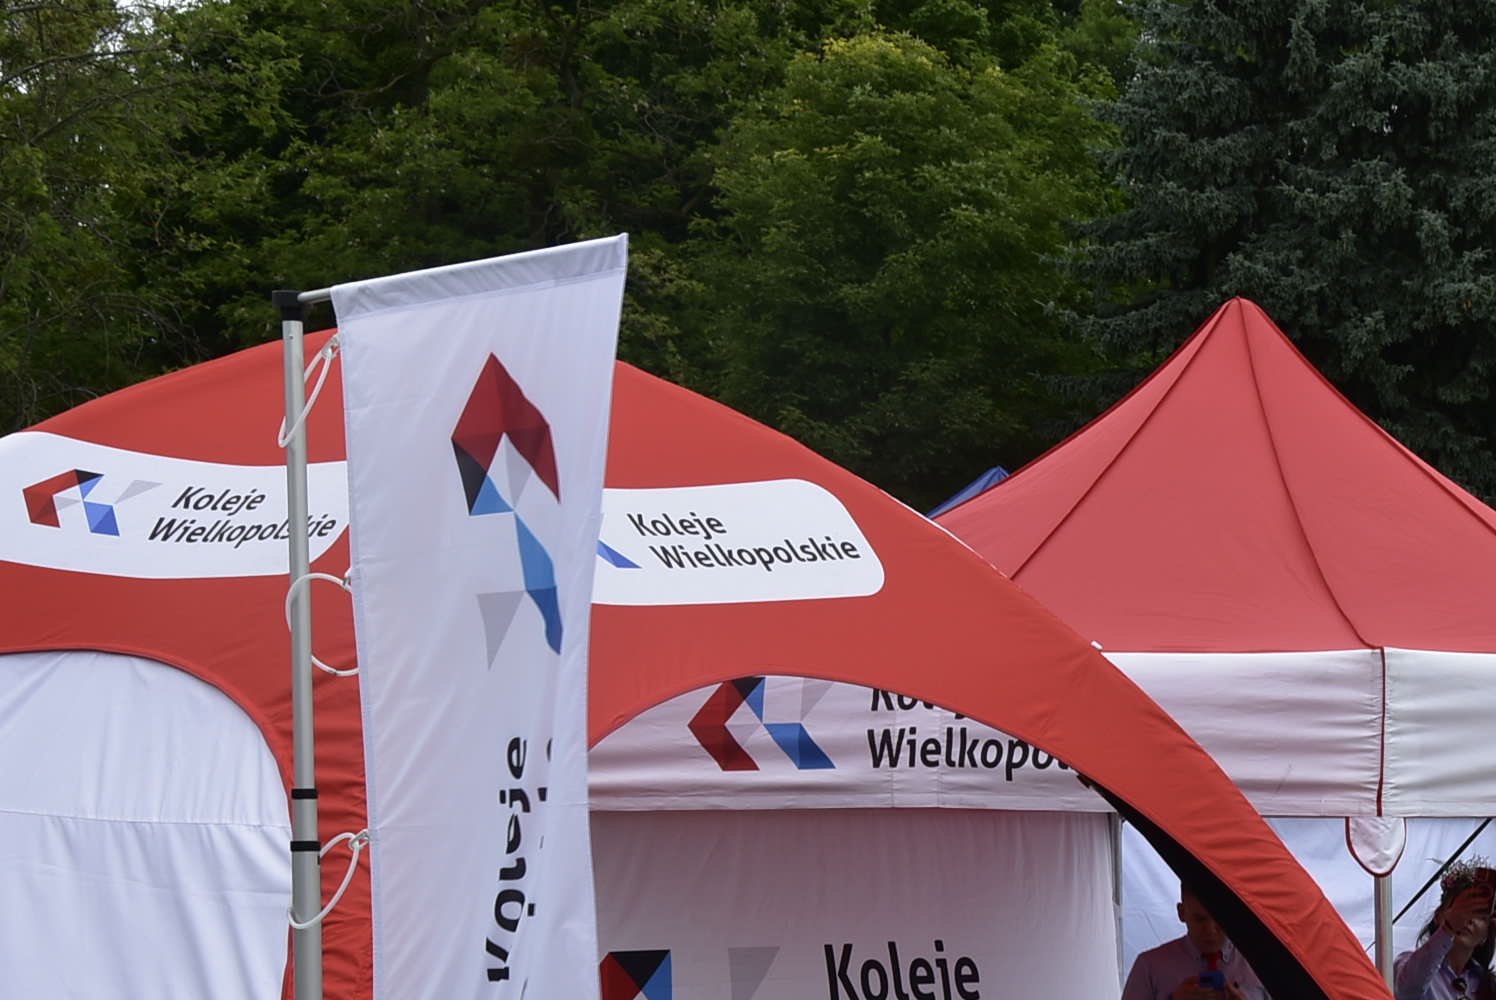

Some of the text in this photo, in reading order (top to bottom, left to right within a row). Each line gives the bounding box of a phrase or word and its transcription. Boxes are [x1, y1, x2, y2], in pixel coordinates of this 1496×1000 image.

[172, 486, 266, 515] Koleje
[627, 512, 727, 539] Koleje
[649, 536, 861, 571] Wielkopolskie
